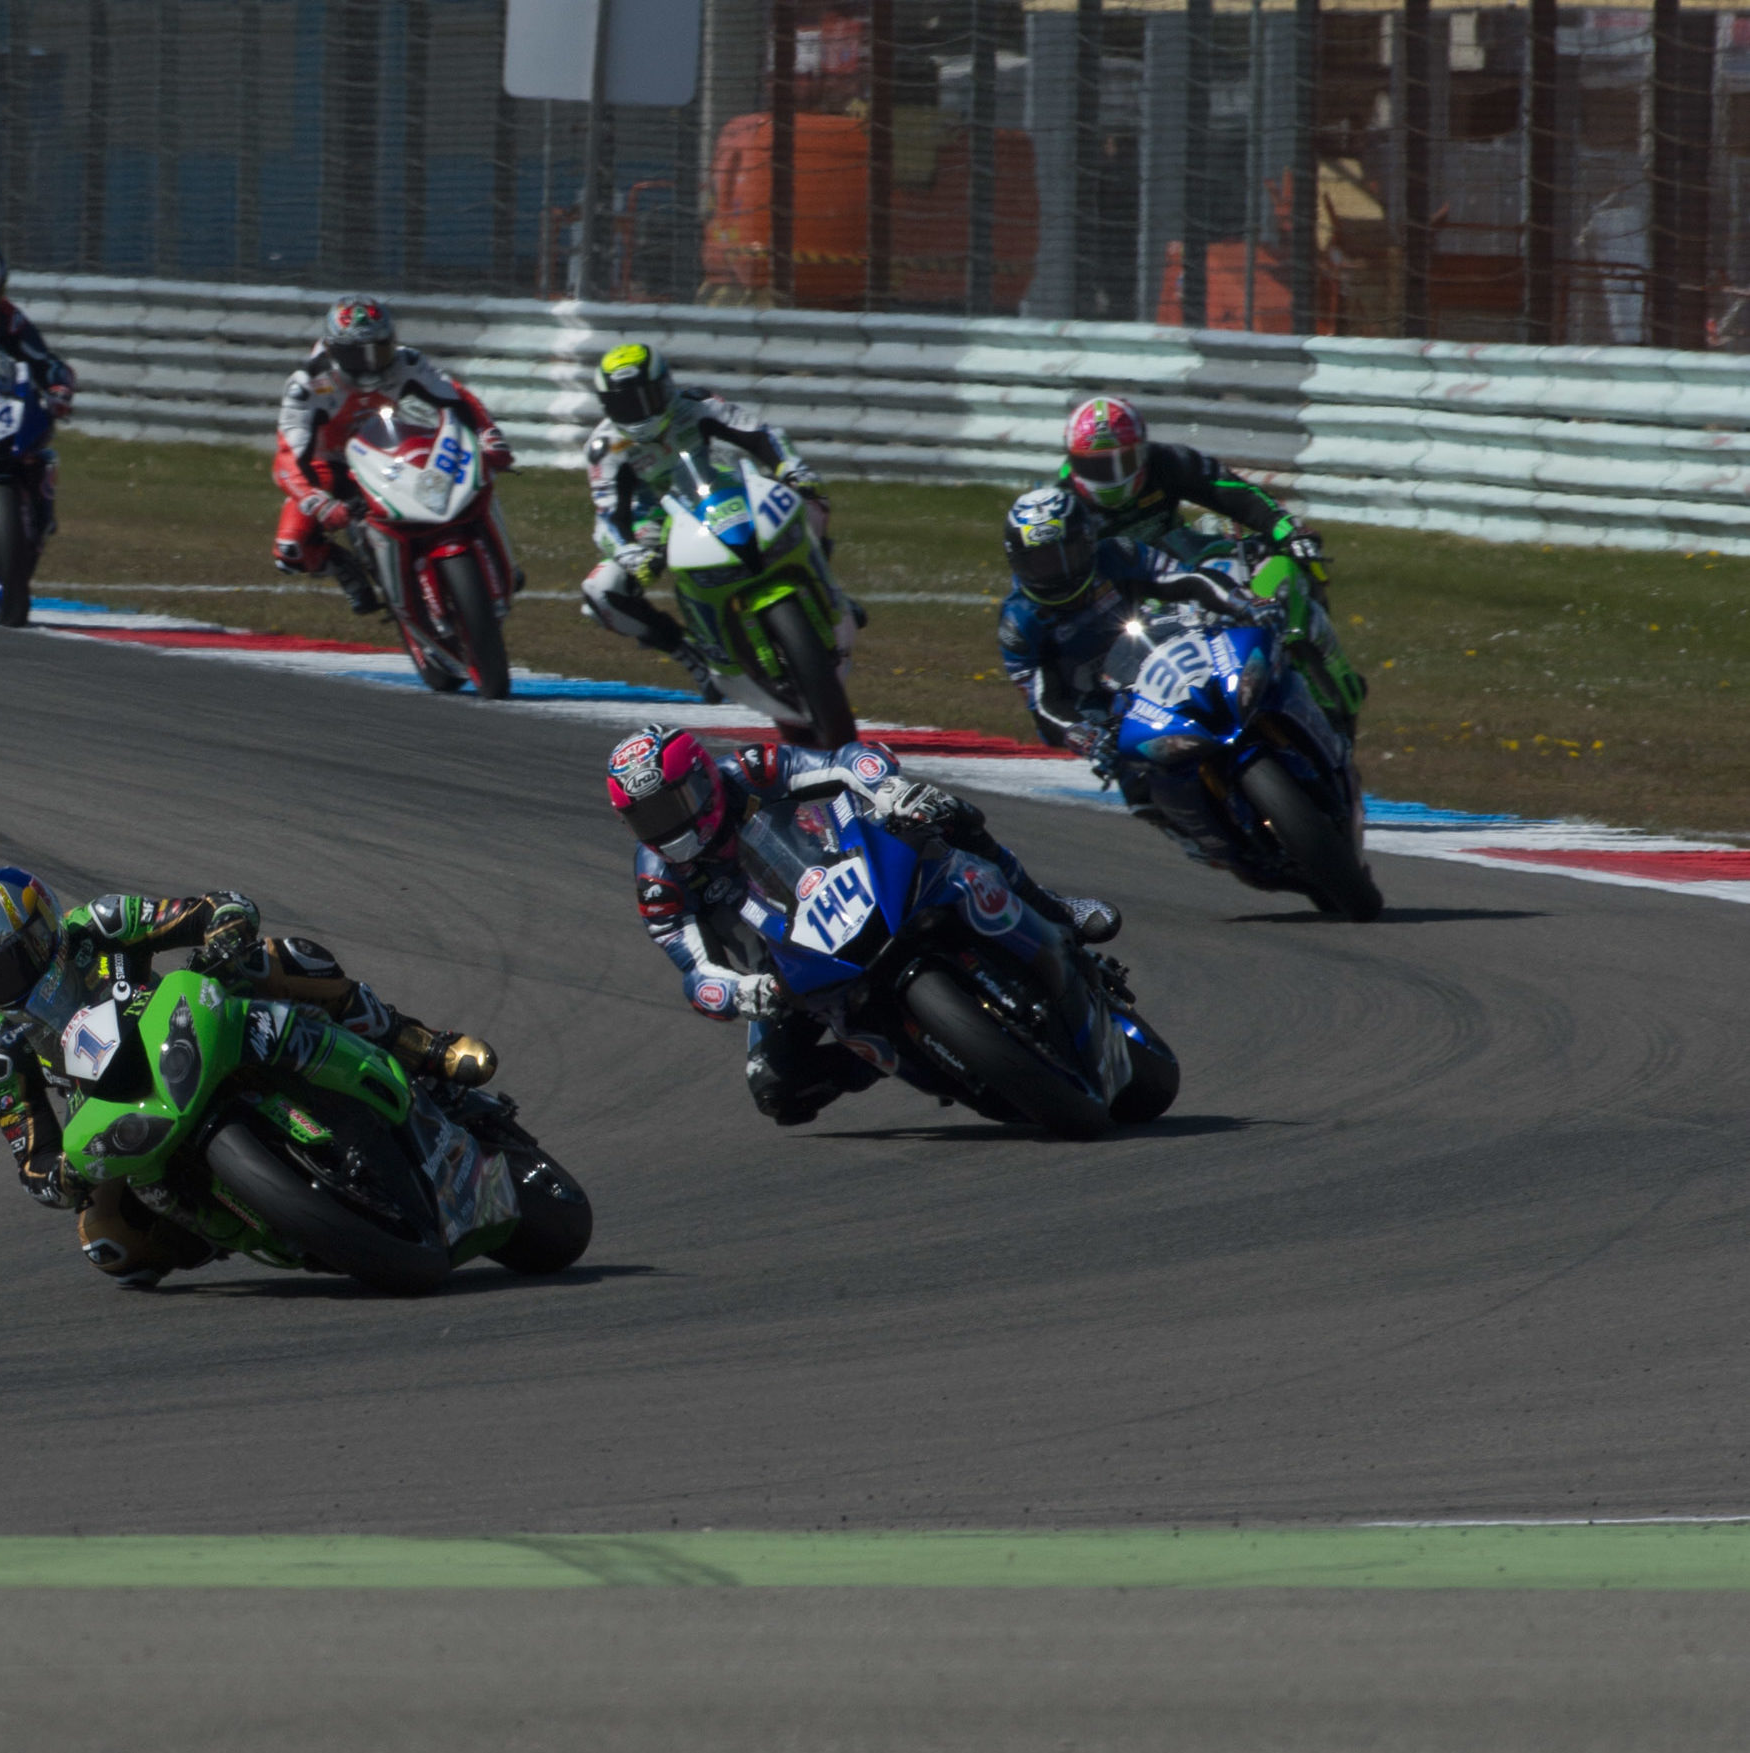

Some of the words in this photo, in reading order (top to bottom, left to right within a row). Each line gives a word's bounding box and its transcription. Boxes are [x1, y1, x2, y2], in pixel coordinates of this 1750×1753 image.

[757, 483, 795, 528] 16
[1144, 641, 1207, 699] 32
[807, 866, 875, 951] 144
[74, 1024, 116, 1076] 1
